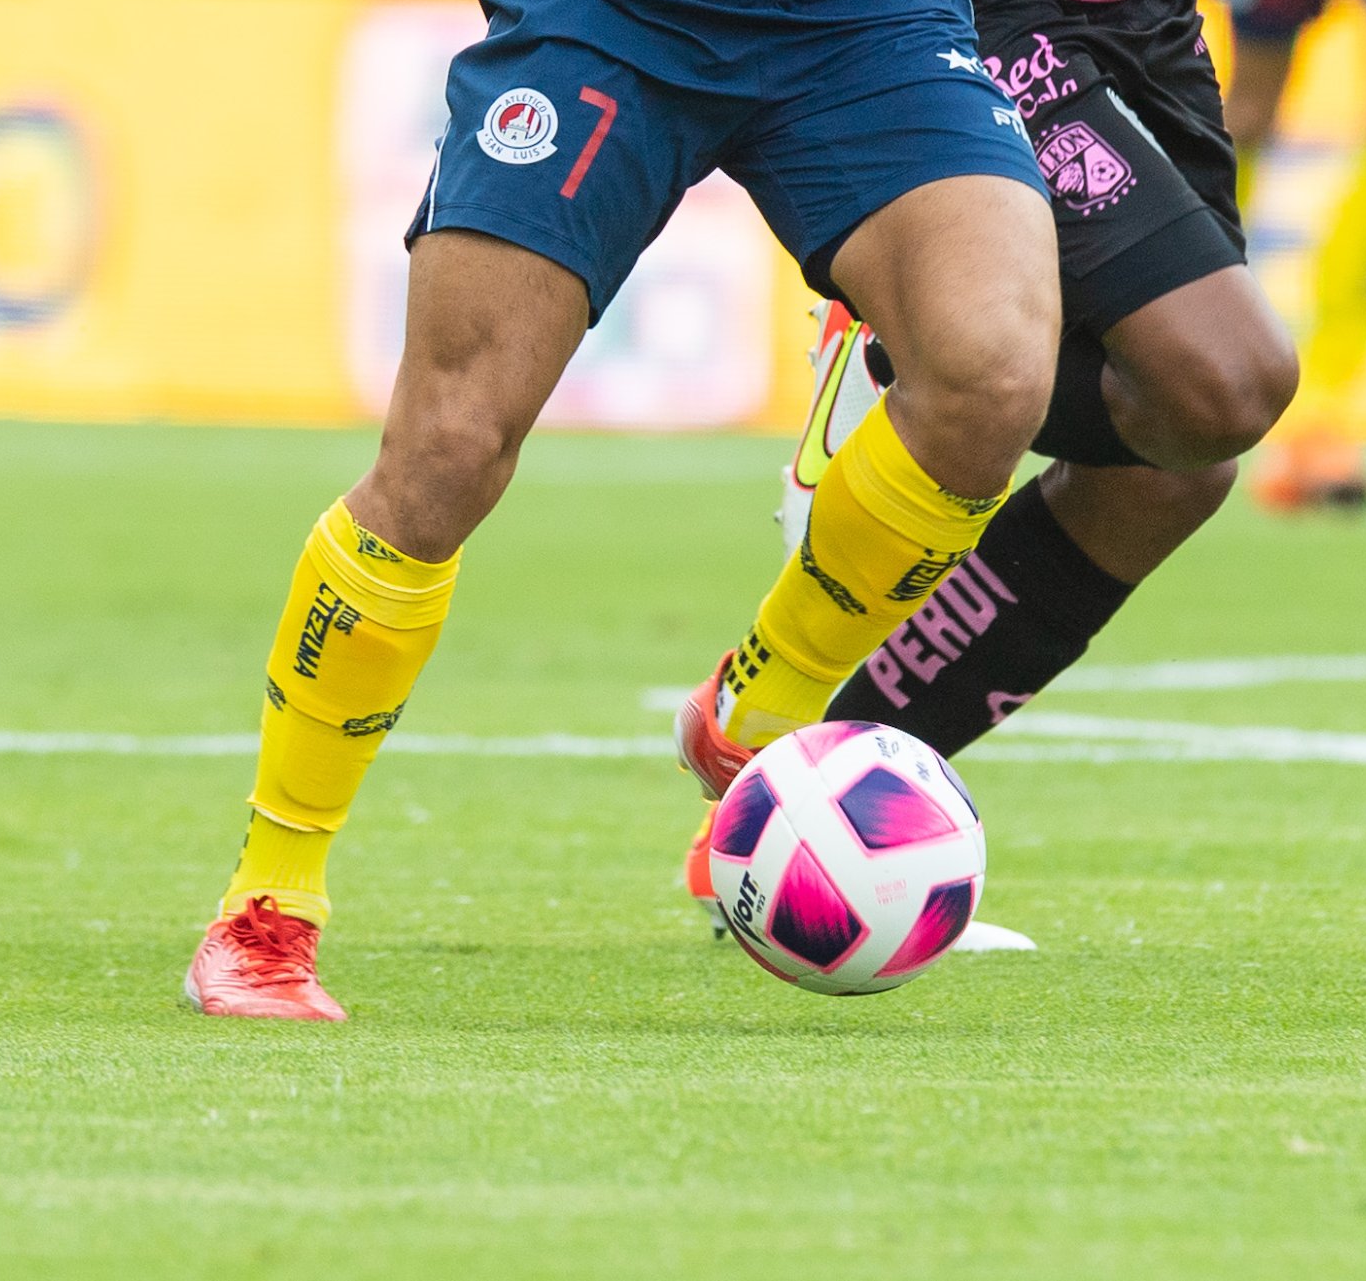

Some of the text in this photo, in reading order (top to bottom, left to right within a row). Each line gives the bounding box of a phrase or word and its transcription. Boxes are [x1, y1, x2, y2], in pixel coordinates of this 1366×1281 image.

[505, 93, 548, 113] ATLÉTICO
[485, 137, 540, 160] SAN LUIS
[559, 85, 618, 200] 7
[293, 582, 342, 680] CTEZUMA
